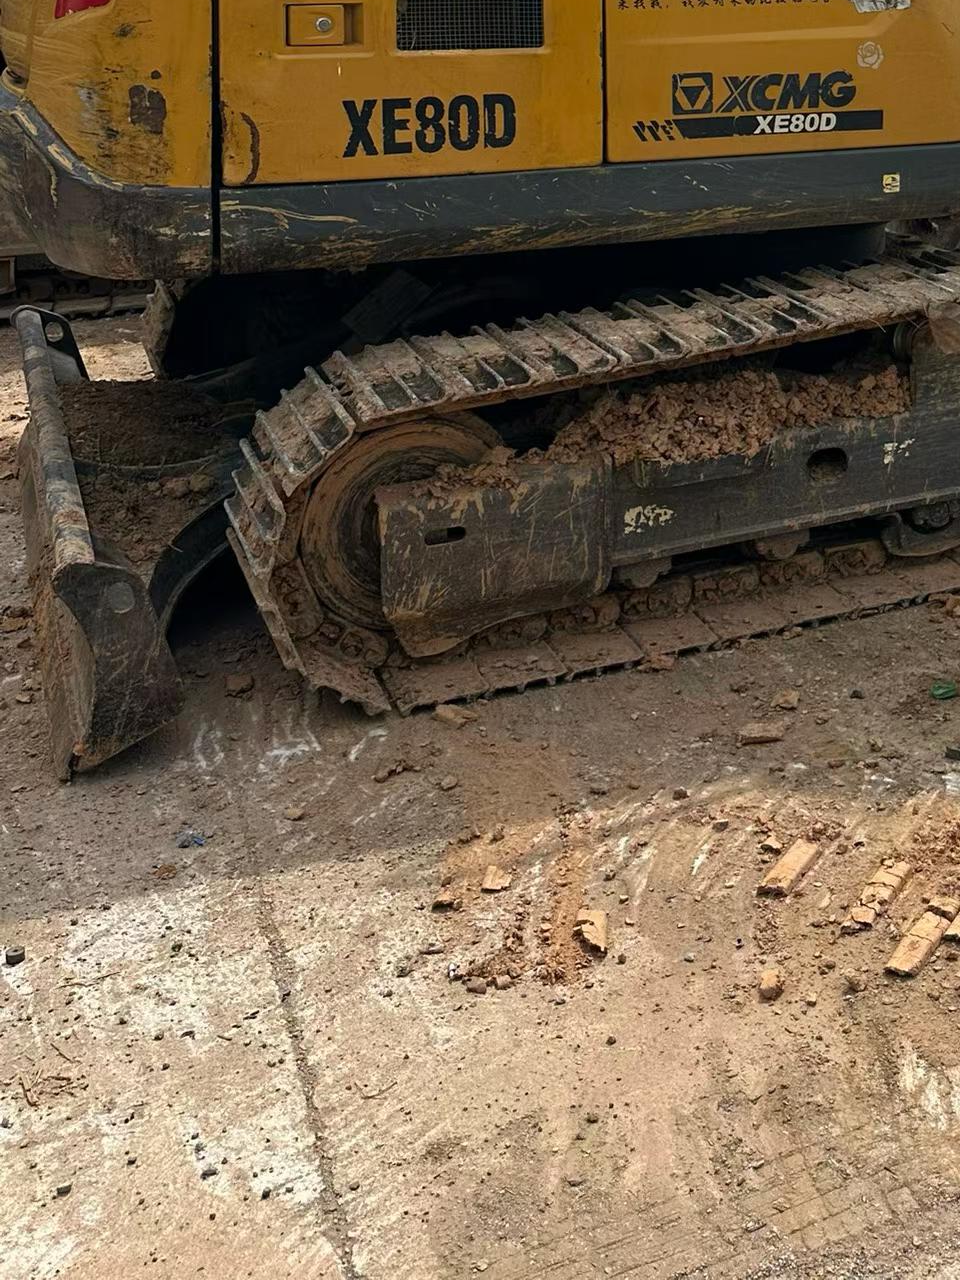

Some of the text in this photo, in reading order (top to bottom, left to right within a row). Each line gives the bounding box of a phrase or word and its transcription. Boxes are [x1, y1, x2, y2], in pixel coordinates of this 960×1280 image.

[715, 70, 857, 113] XCMG
[342, 93, 516, 158] XE80D
[752, 112, 837, 135] XE80D
